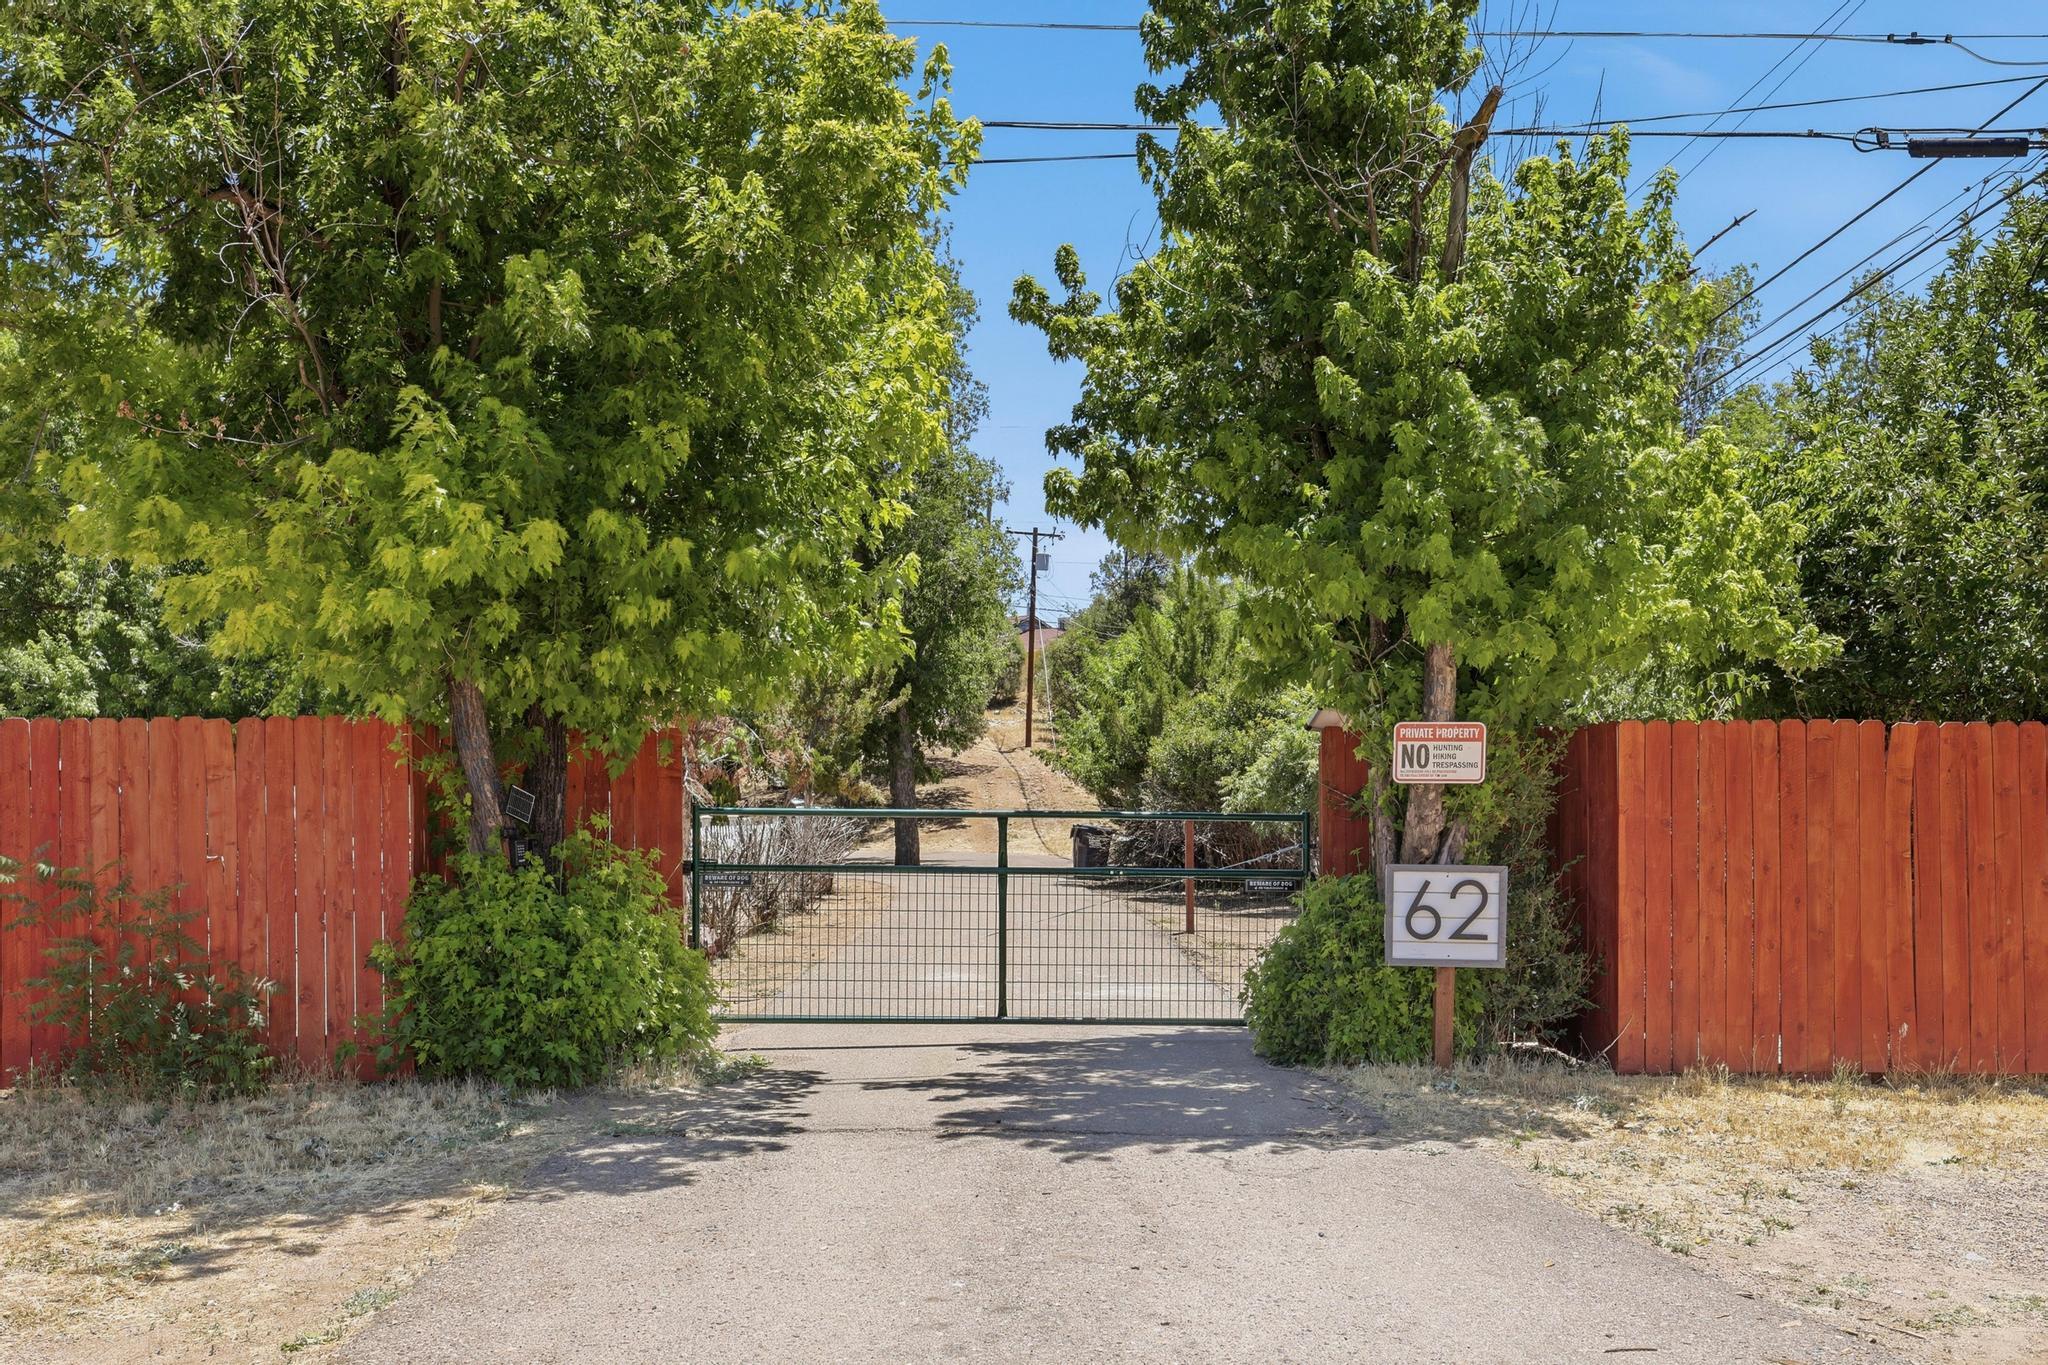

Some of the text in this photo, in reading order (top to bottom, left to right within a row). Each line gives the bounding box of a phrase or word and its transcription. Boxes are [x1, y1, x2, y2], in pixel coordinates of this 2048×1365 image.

[1400, 727, 1480, 738] PRIVATE PROPERTY
[1401, 743, 1430, 769] NO
[1405, 879, 1489, 941] 62
